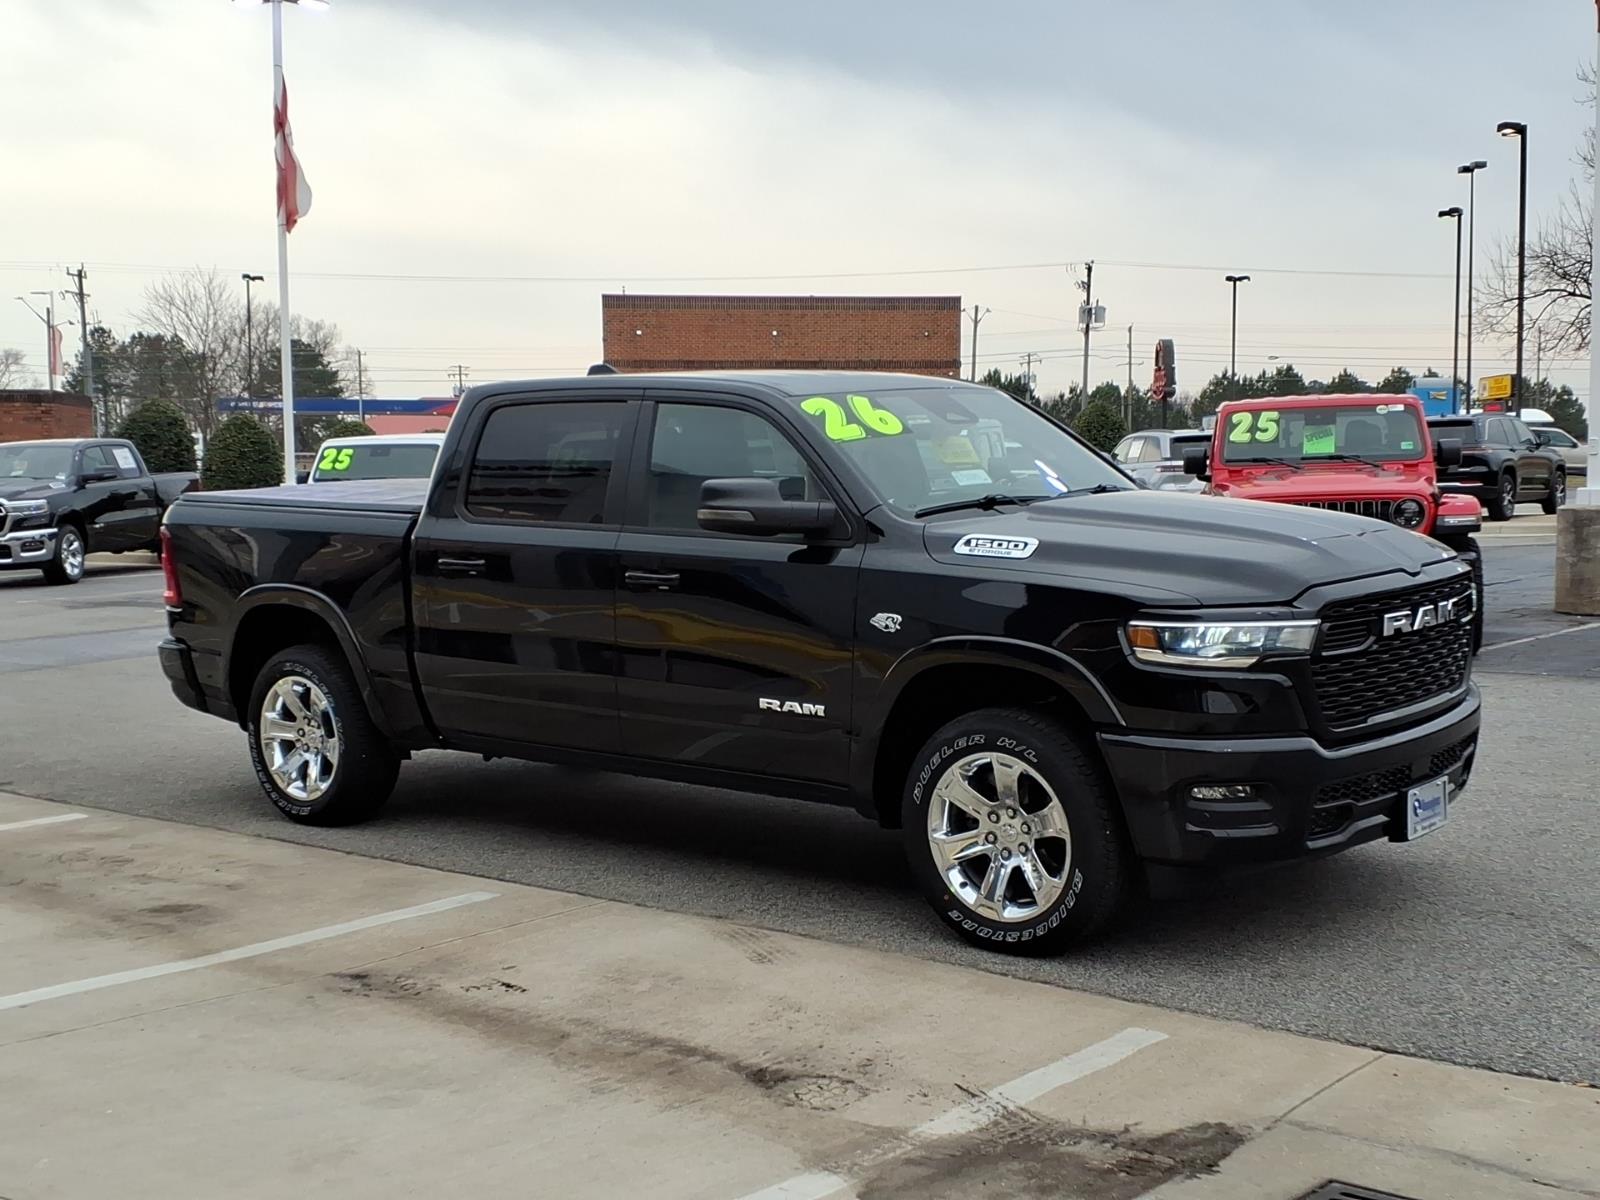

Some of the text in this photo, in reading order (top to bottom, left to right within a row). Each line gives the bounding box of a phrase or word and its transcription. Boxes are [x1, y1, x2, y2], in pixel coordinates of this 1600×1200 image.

[801, 394, 905, 443] 26
[1229, 411, 1281, 443] 25
[318, 448, 354, 470] 25
[969, 538, 1026, 551] 1500
[1383, 598, 1458, 636] RAM
[759, 697, 826, 717] RAM
[912, 734, 986, 804] DUELER
[947, 868, 1084, 942] BRIDGESTONE
